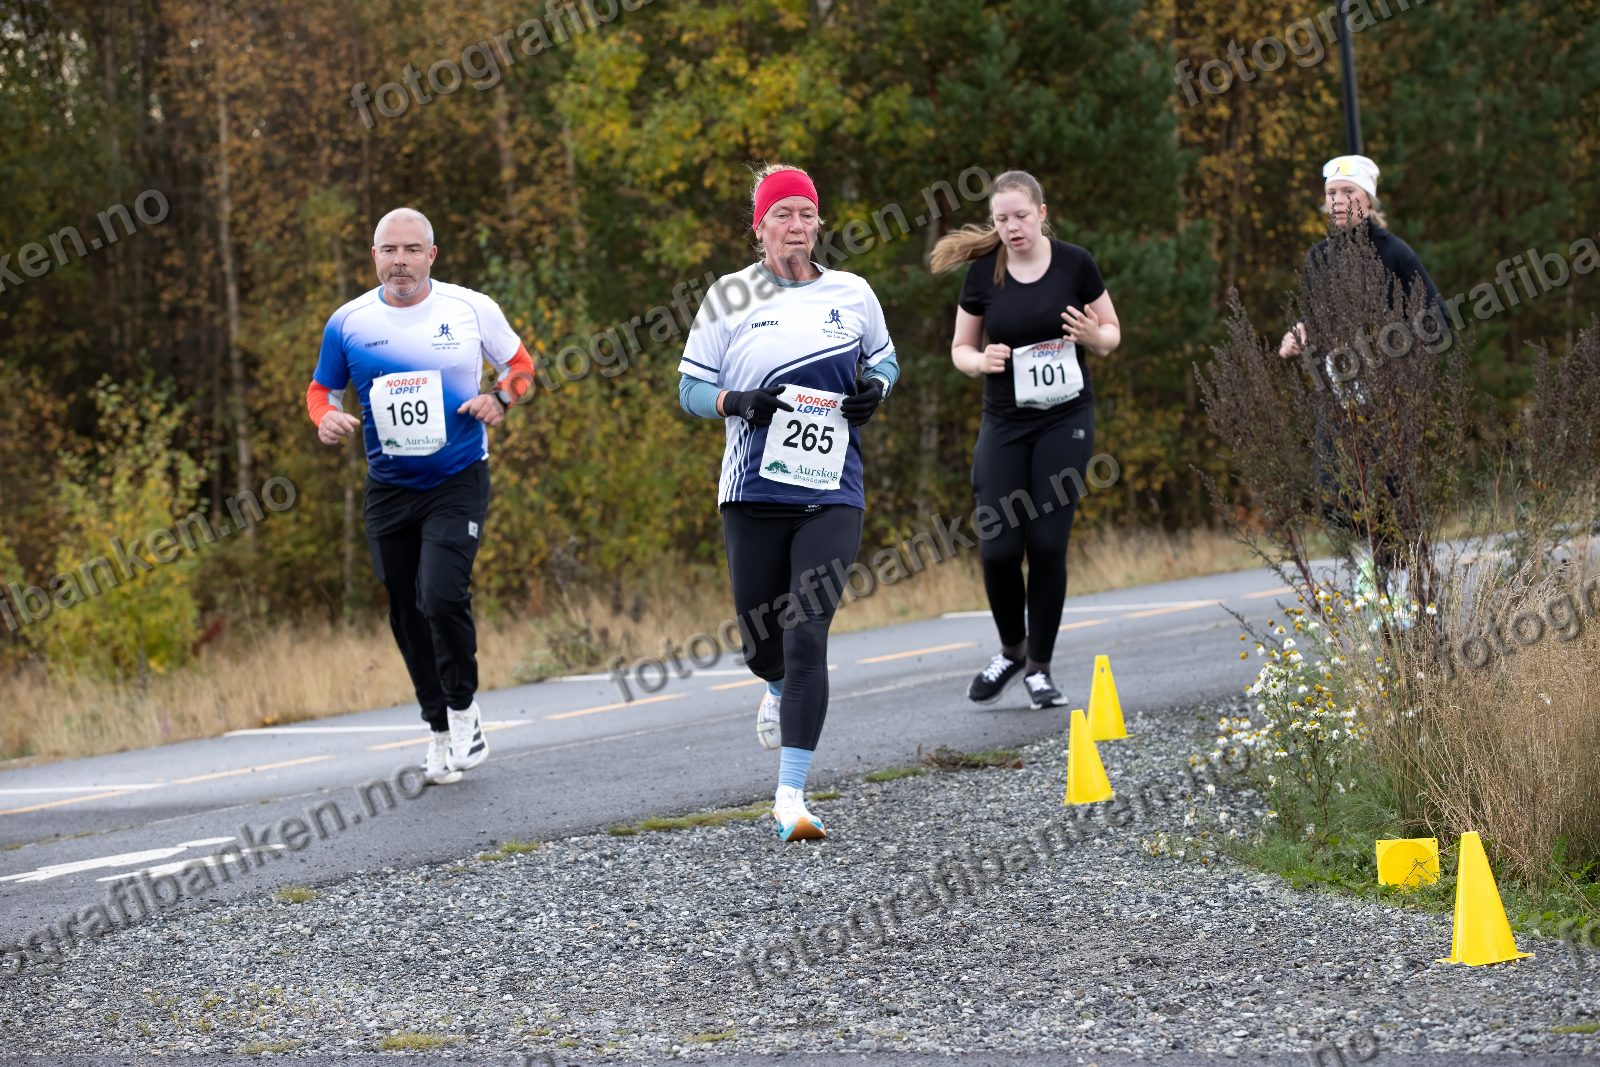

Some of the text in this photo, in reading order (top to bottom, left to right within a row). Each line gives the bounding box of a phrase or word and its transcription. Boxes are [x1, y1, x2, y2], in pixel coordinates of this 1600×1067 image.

[751, 320, 779, 329] TRIMTEX
[1028, 362, 1066, 387] 101
[385, 377, 428, 388] NORGES
[389, 385, 422, 395] LØPET
[794, 393, 838, 409] NORGES
[386, 399, 429, 426] 169
[796, 403, 831, 417] LØPET
[404, 435, 443, 447] Aurskog
[782, 419, 835, 455] 265
[795, 463, 838, 481] Aurskog
